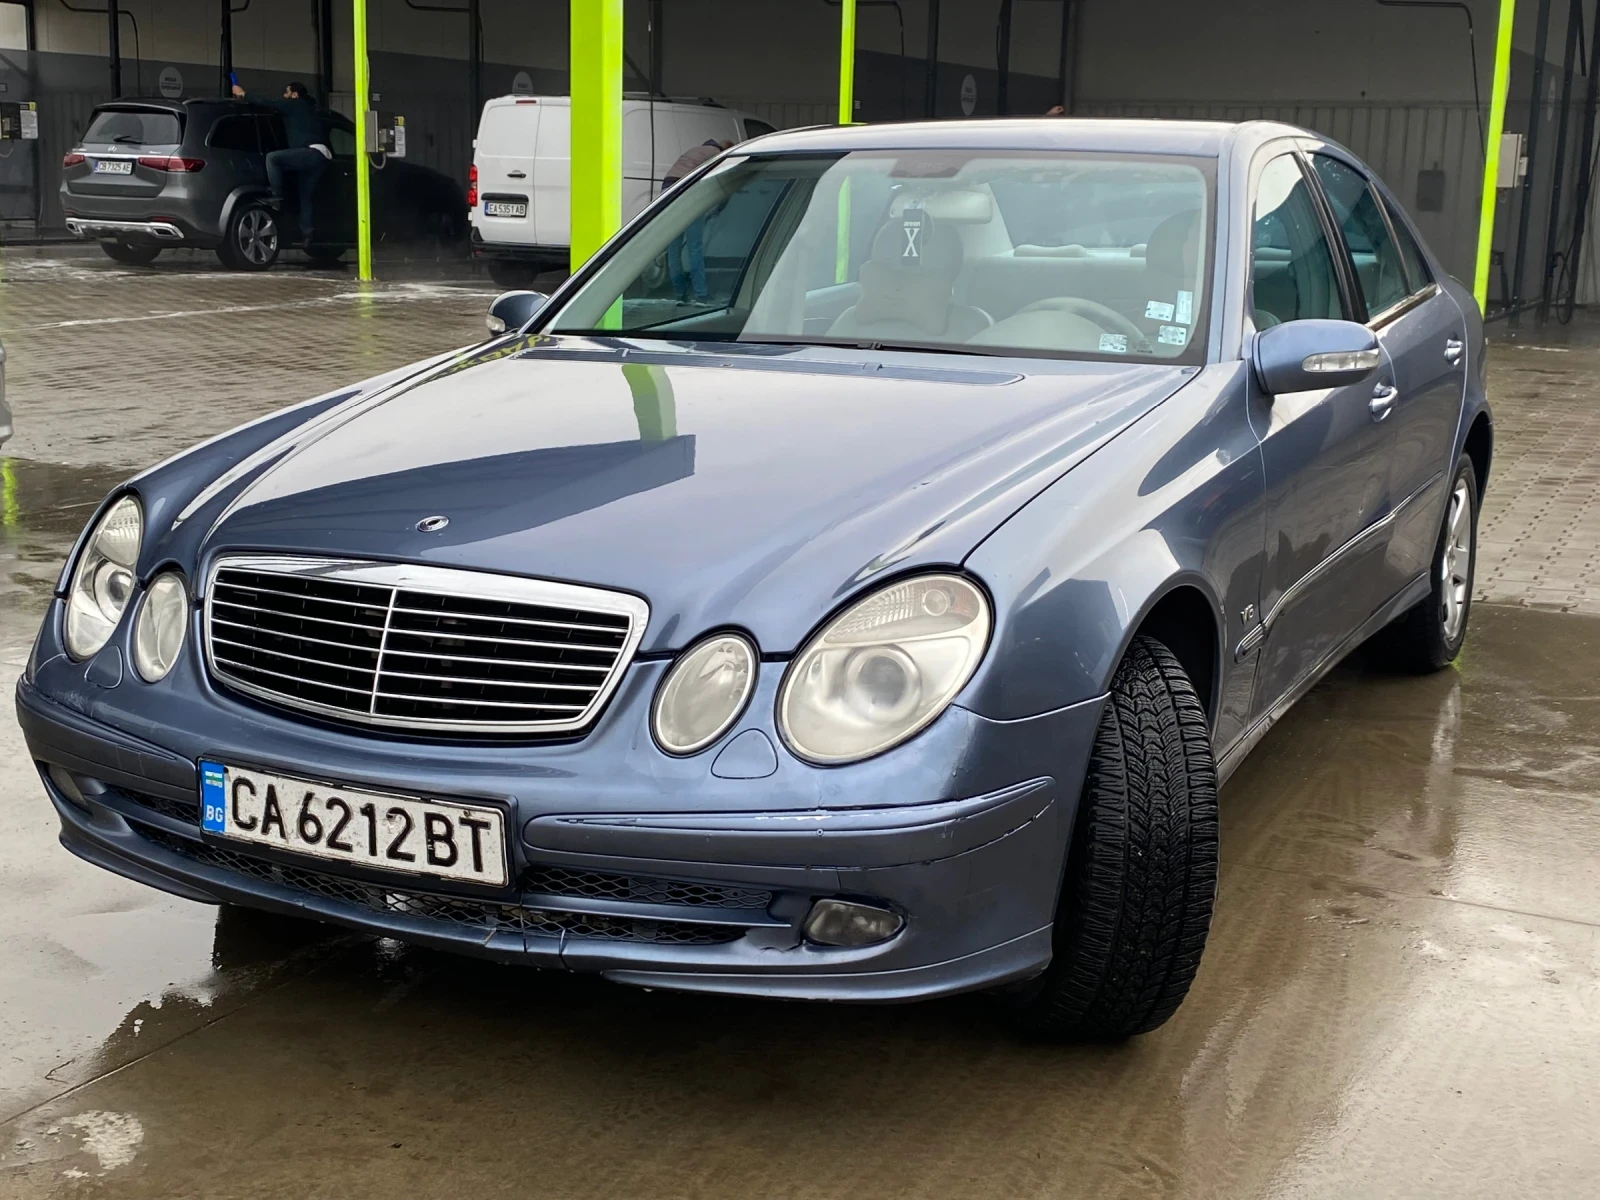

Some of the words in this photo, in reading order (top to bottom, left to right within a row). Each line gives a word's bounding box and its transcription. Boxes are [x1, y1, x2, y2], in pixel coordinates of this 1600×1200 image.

[489, 203, 497, 213] EA
[498, 204, 514, 214] 5351
[902, 228, 920, 257] X
[206, 804, 224, 823] BG
